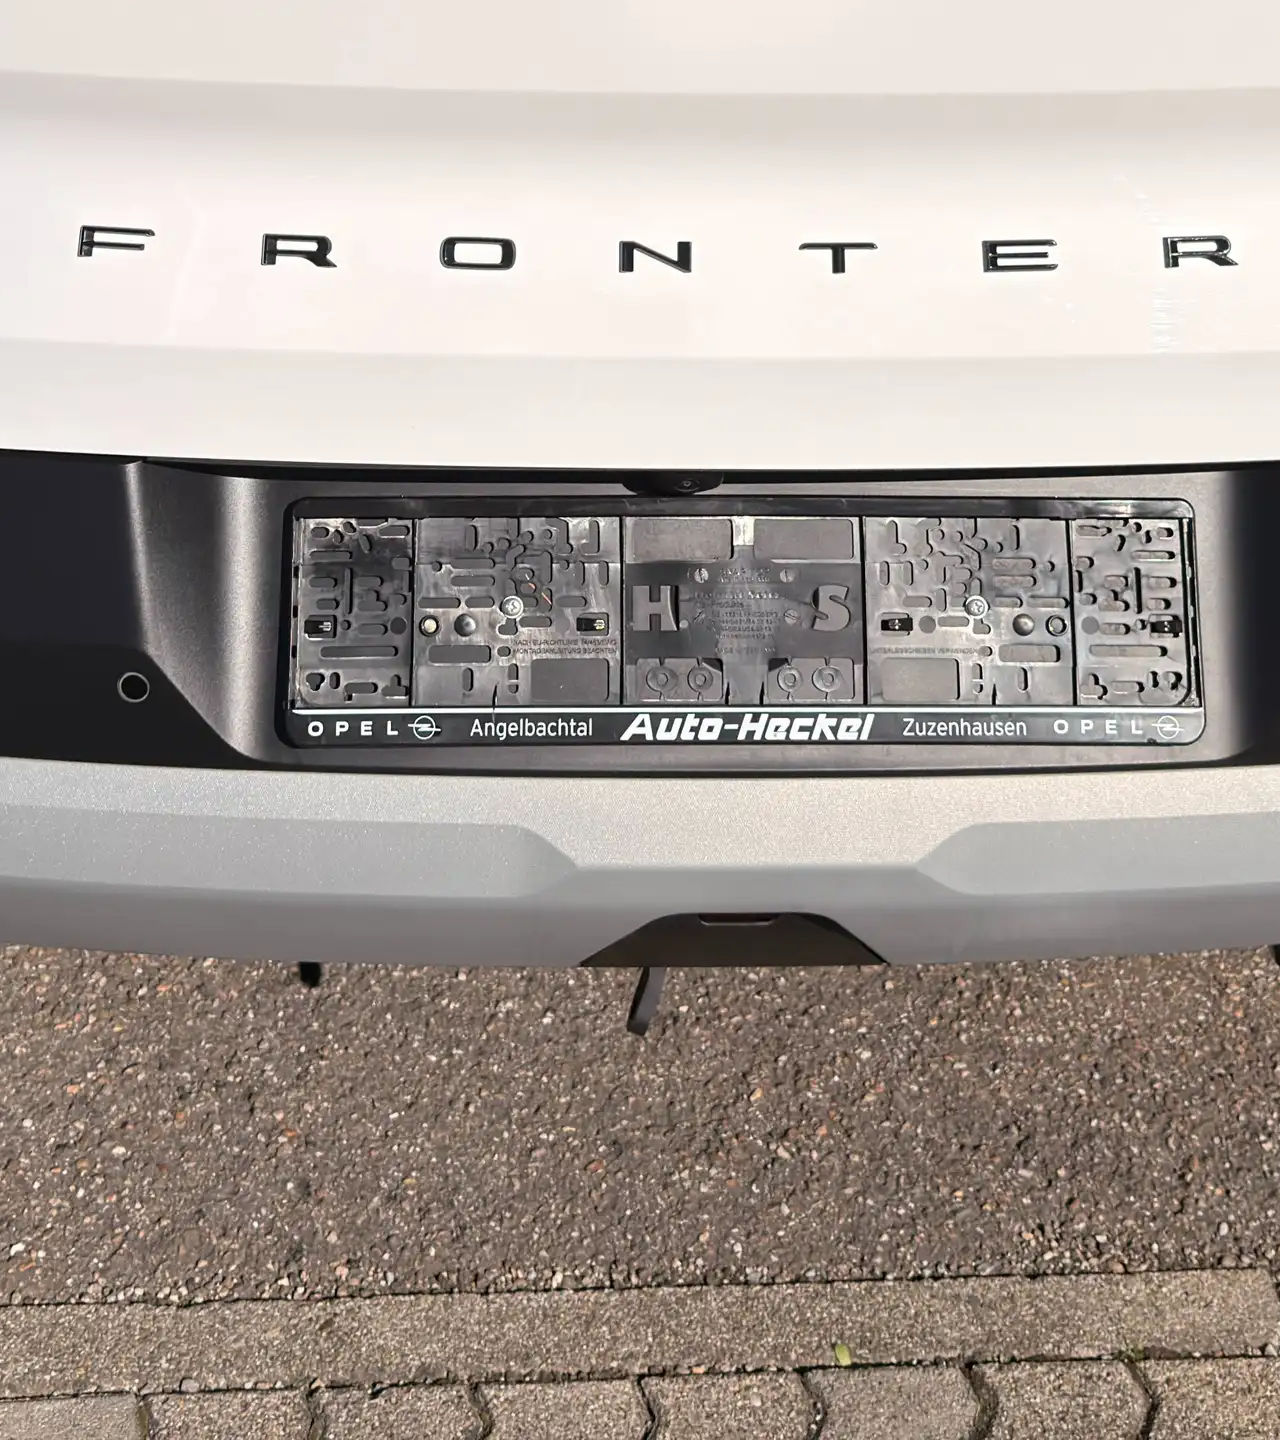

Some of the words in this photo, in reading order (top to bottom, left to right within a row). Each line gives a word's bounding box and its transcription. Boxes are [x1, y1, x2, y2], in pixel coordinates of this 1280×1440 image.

[307, 720, 399, 737] OPEL
[469, 717, 593, 740] Angelbachtal
[620, 713, 874, 741] Auto-Heckel
[902, 717, 1027, 737] Zuzenhausen
[1053, 719, 1144, 735] OPEL
